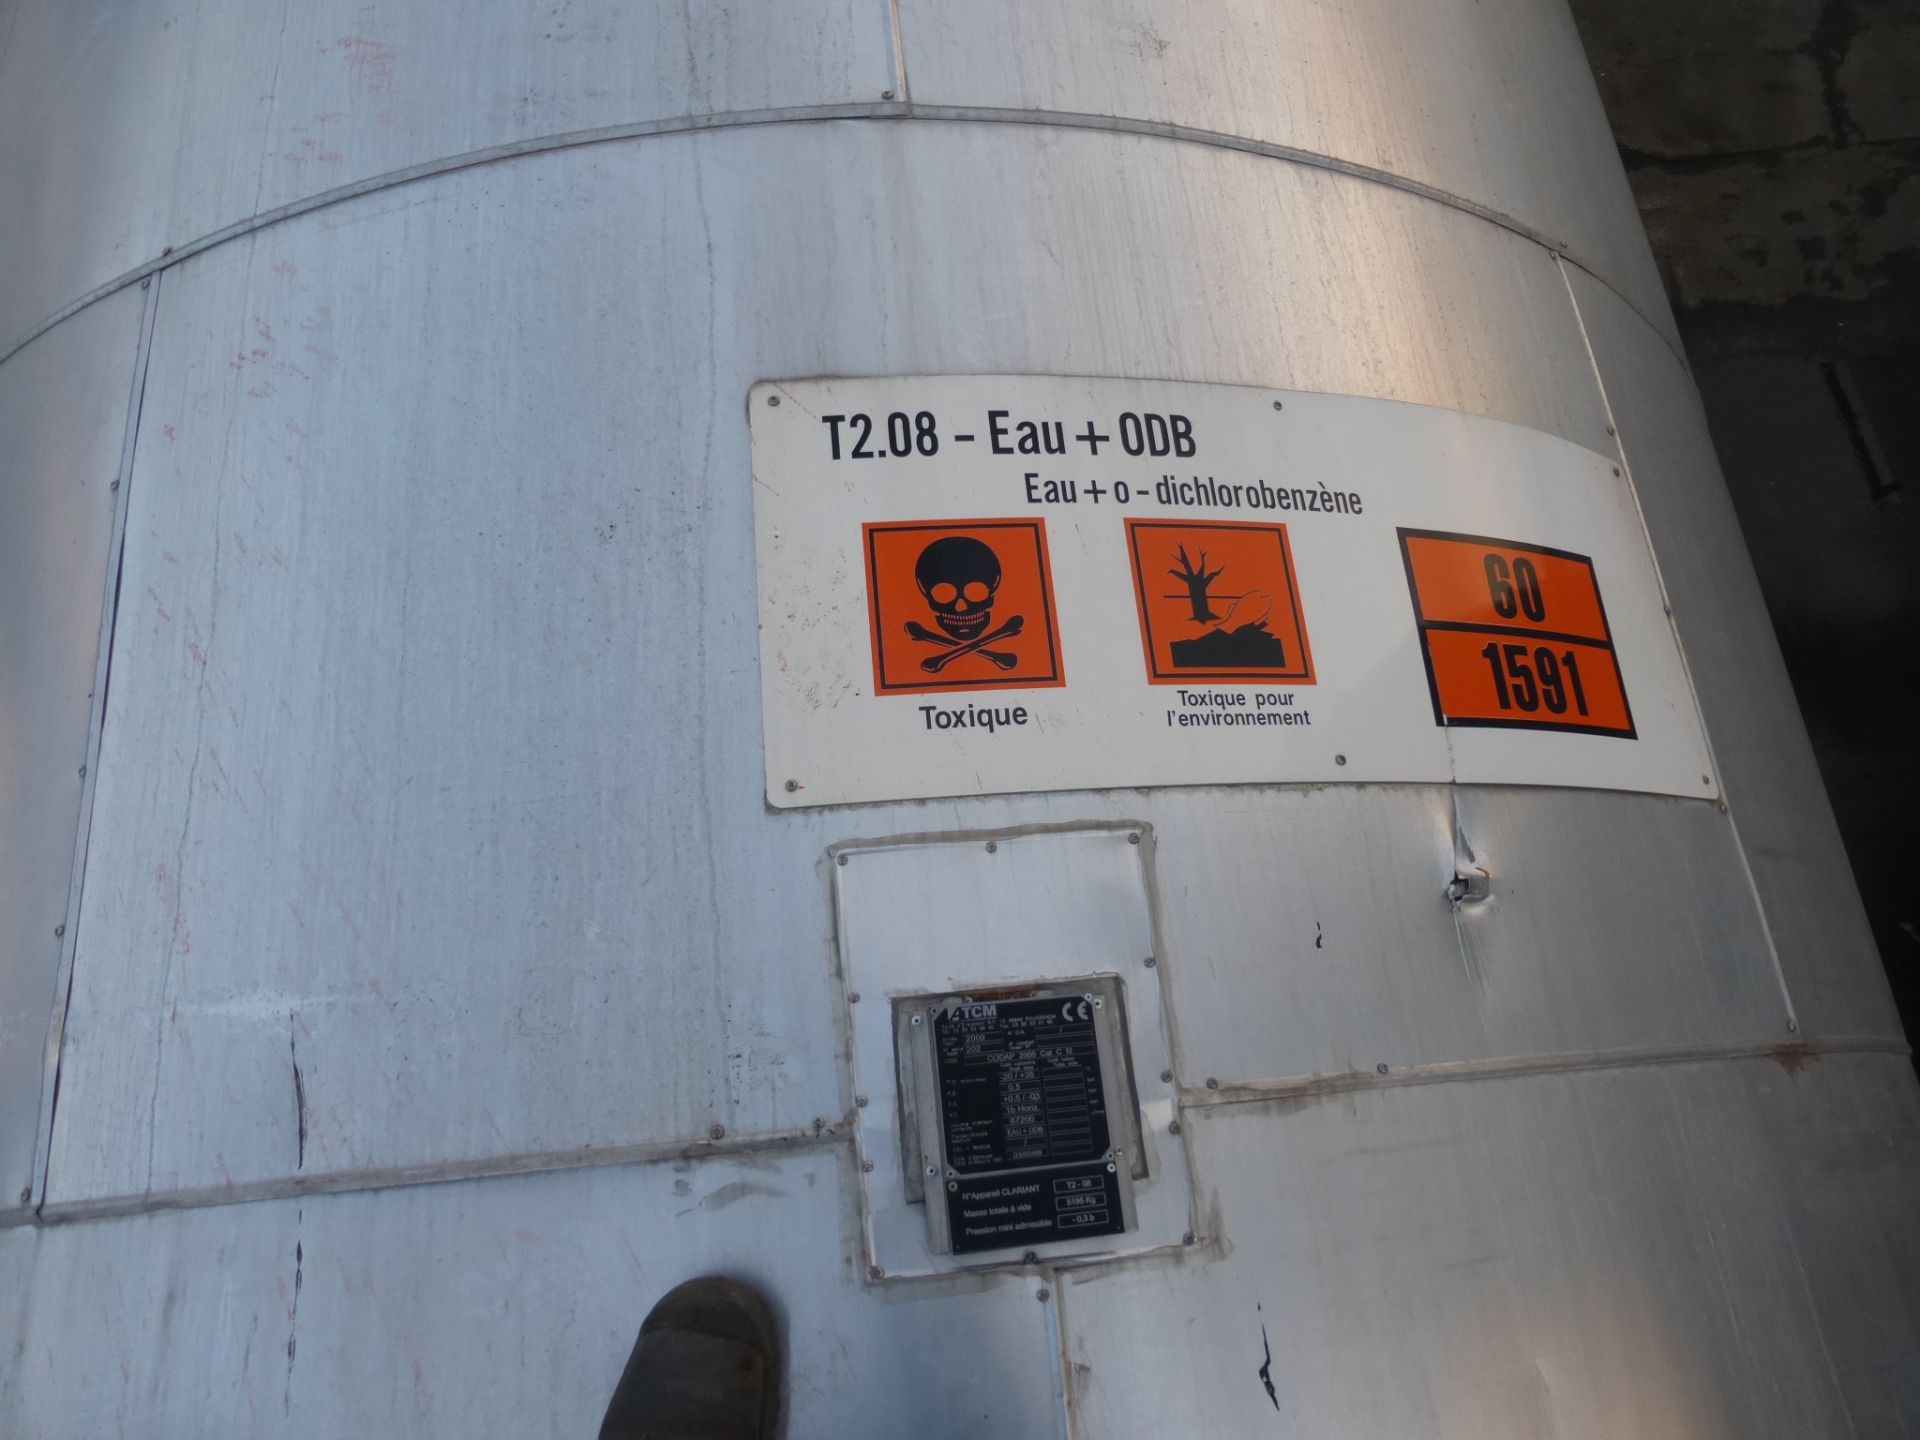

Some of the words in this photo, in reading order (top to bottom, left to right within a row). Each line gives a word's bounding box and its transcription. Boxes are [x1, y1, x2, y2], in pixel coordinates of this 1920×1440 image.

[822, 410, 939, 460] T2.08
[988, 410, 1066, 455] Eau
[1076, 420, 1110, 456] +
[1118, 411, 1197, 457] ODB
[1024, 472, 1077, 504] Eau
[1084, 479, 1107, 504] +
[1113, 480, 1130, 504] o
[1155, 475, 1363, 515] dichlorobenzène
[1483, 552, 1546, 623] 60
[1481, 641, 1590, 717] 1591
[1177, 689, 1246, 710] Toxique
[1255, 692, 1294, 710] pour
[918, 702, 1029, 732] Toxique
[1166, 709, 1311, 727] l'environnement
[961, 1004, 997, 1019] TCM
[1062, 1001, 1089, 1022] CE
[965, 1034, 985, 1043] 2009
[966, 1045, 981, 1054] 202
[987, 1053, 1015, 1063] CODAP
[1001, 1184, 1040, 1196] CLARIANT
[989, 1205, 1009, 1215] totale
[1017, 1203, 1032, 1212] vide
[965, 1225, 997, 1236] Pression
